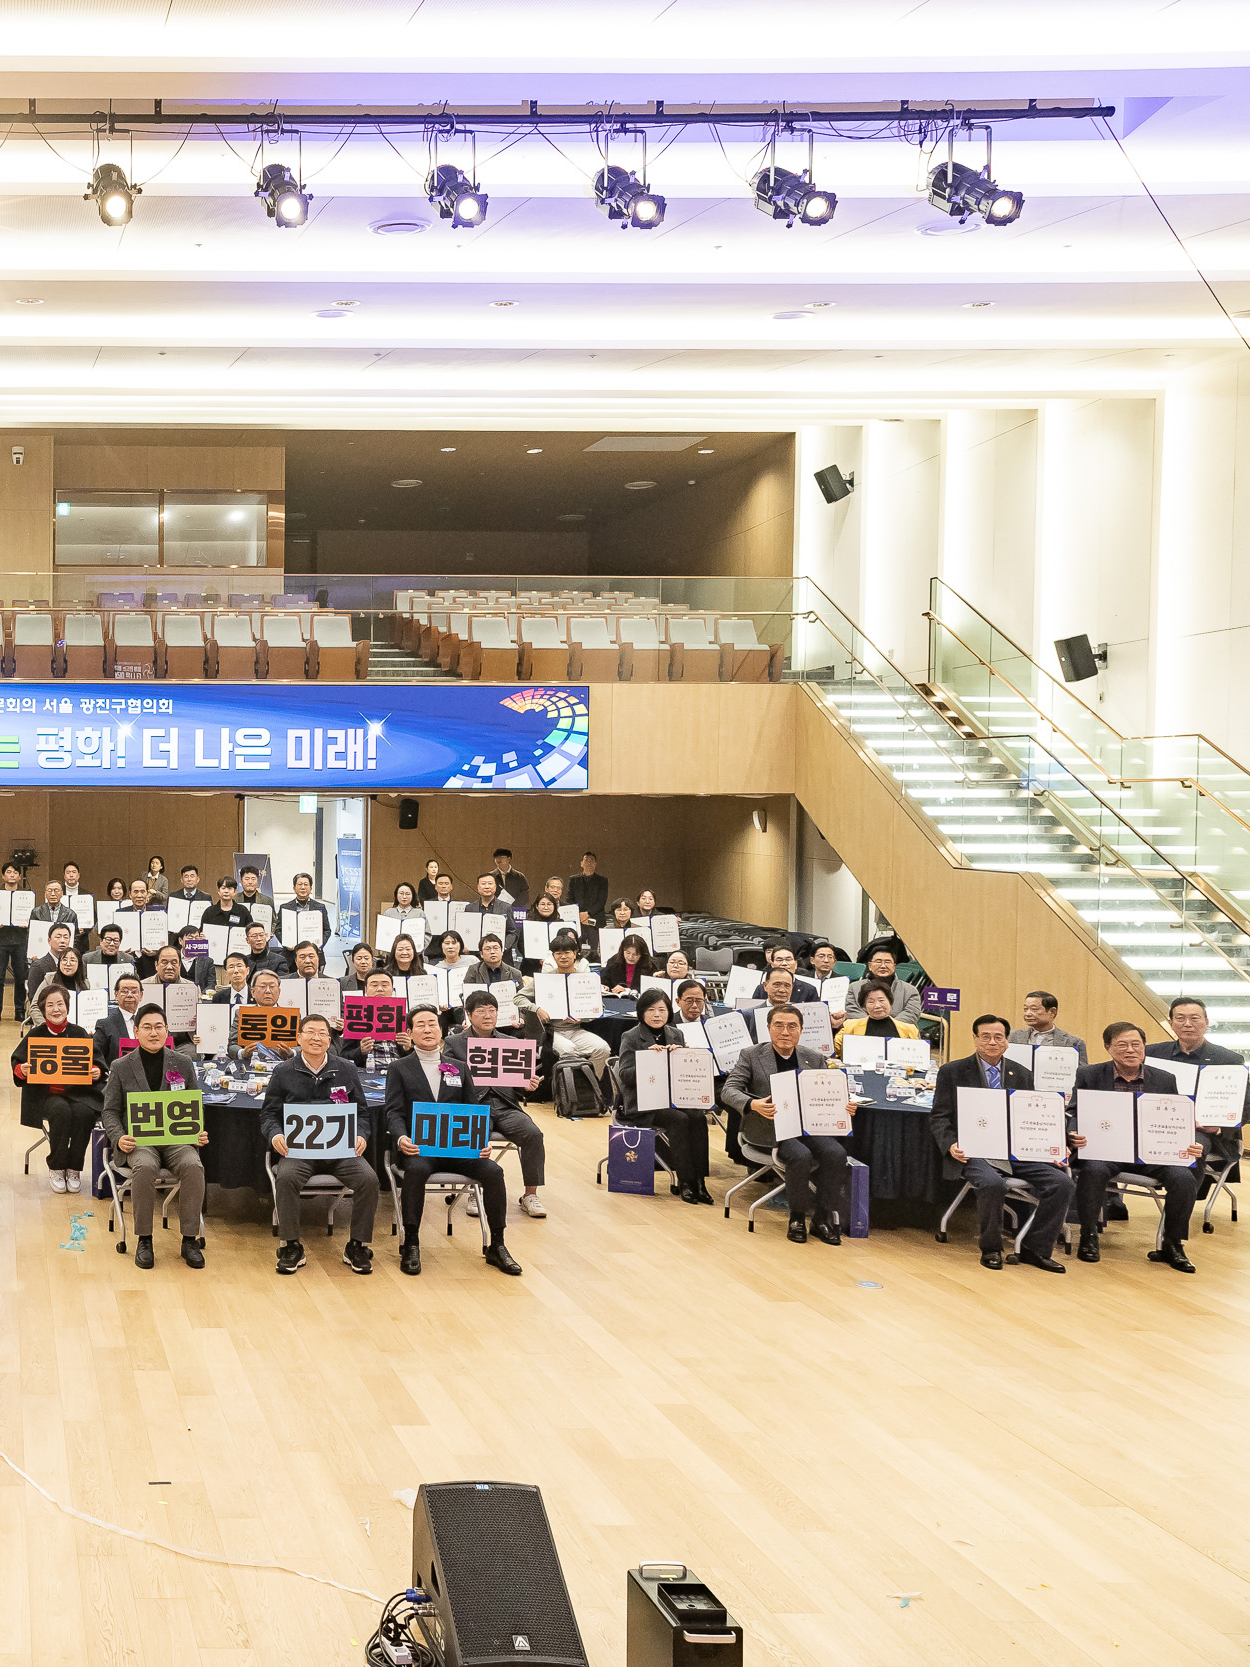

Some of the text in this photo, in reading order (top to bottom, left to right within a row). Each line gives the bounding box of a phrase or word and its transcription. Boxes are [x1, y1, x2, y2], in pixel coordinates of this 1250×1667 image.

[43, 698, 73, 714] 서울
[80, 698, 173, 715] 광진구협의회
[37, 727, 127, 769] 평화!
[143, 727, 179, 769] 더
[196, 727, 272, 770] 나은
[287, 727, 378, 771] 미래!
[237, 1011, 300, 1041] 통일
[346, 1003, 406, 1035] 평화
[468, 1045, 536, 1080] 협력
[130, 1100, 201, 1137] 번영
[285, 1112, 356, 1150] 22기
[413, 1112, 490, 1150] 미래
